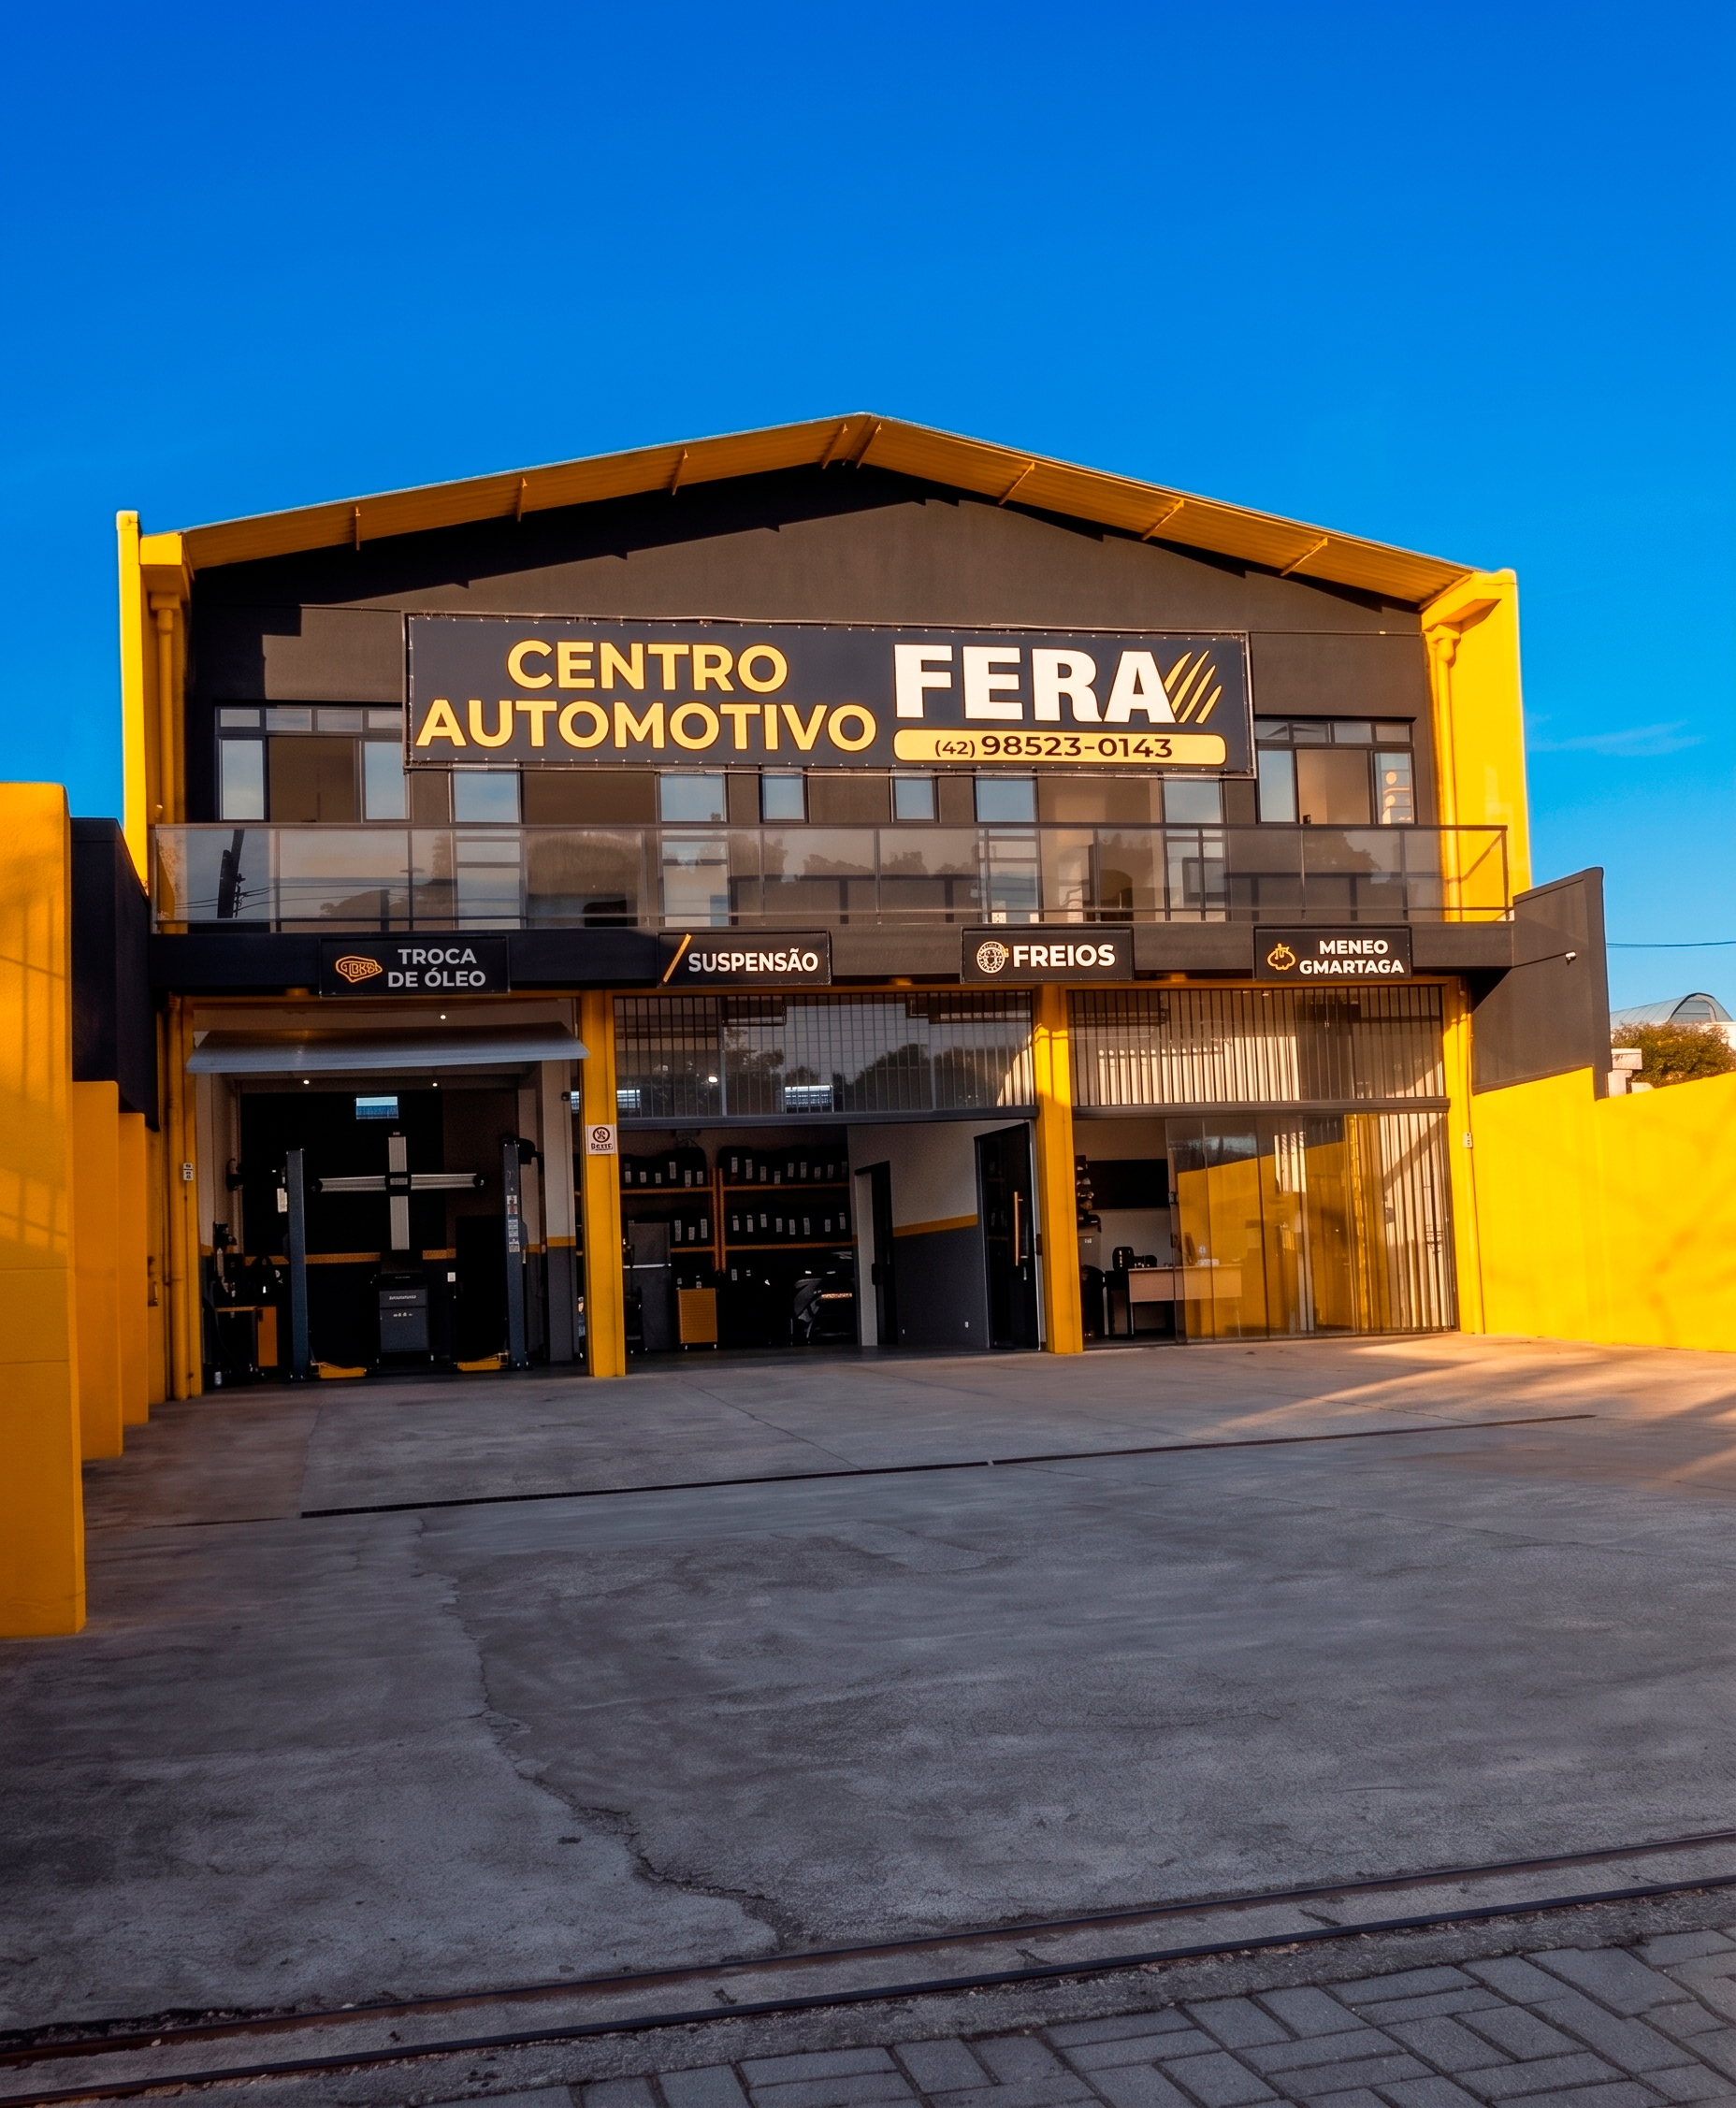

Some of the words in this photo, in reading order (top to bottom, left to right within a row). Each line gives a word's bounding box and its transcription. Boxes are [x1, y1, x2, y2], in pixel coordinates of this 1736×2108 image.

[507, 639, 788, 693] CENTRO
[893, 644, 1178, 724] FERA
[415, 699, 877, 752] AUTOMOTIVO
[935, 739, 976, 758] (42)
[981, 735, 1173, 758] 98523-0143
[397, 947, 477, 965] TROCA
[1012, 944, 1116, 968] FREIOS
[1319, 939, 1389, 955] MENEO
[687, 947, 818, 973] SUSPENSÃO
[1298, 959, 1405, 975] GMARTAGA
[387, 971, 419, 988] DE
[424, 967, 486, 988] ÓLEO
